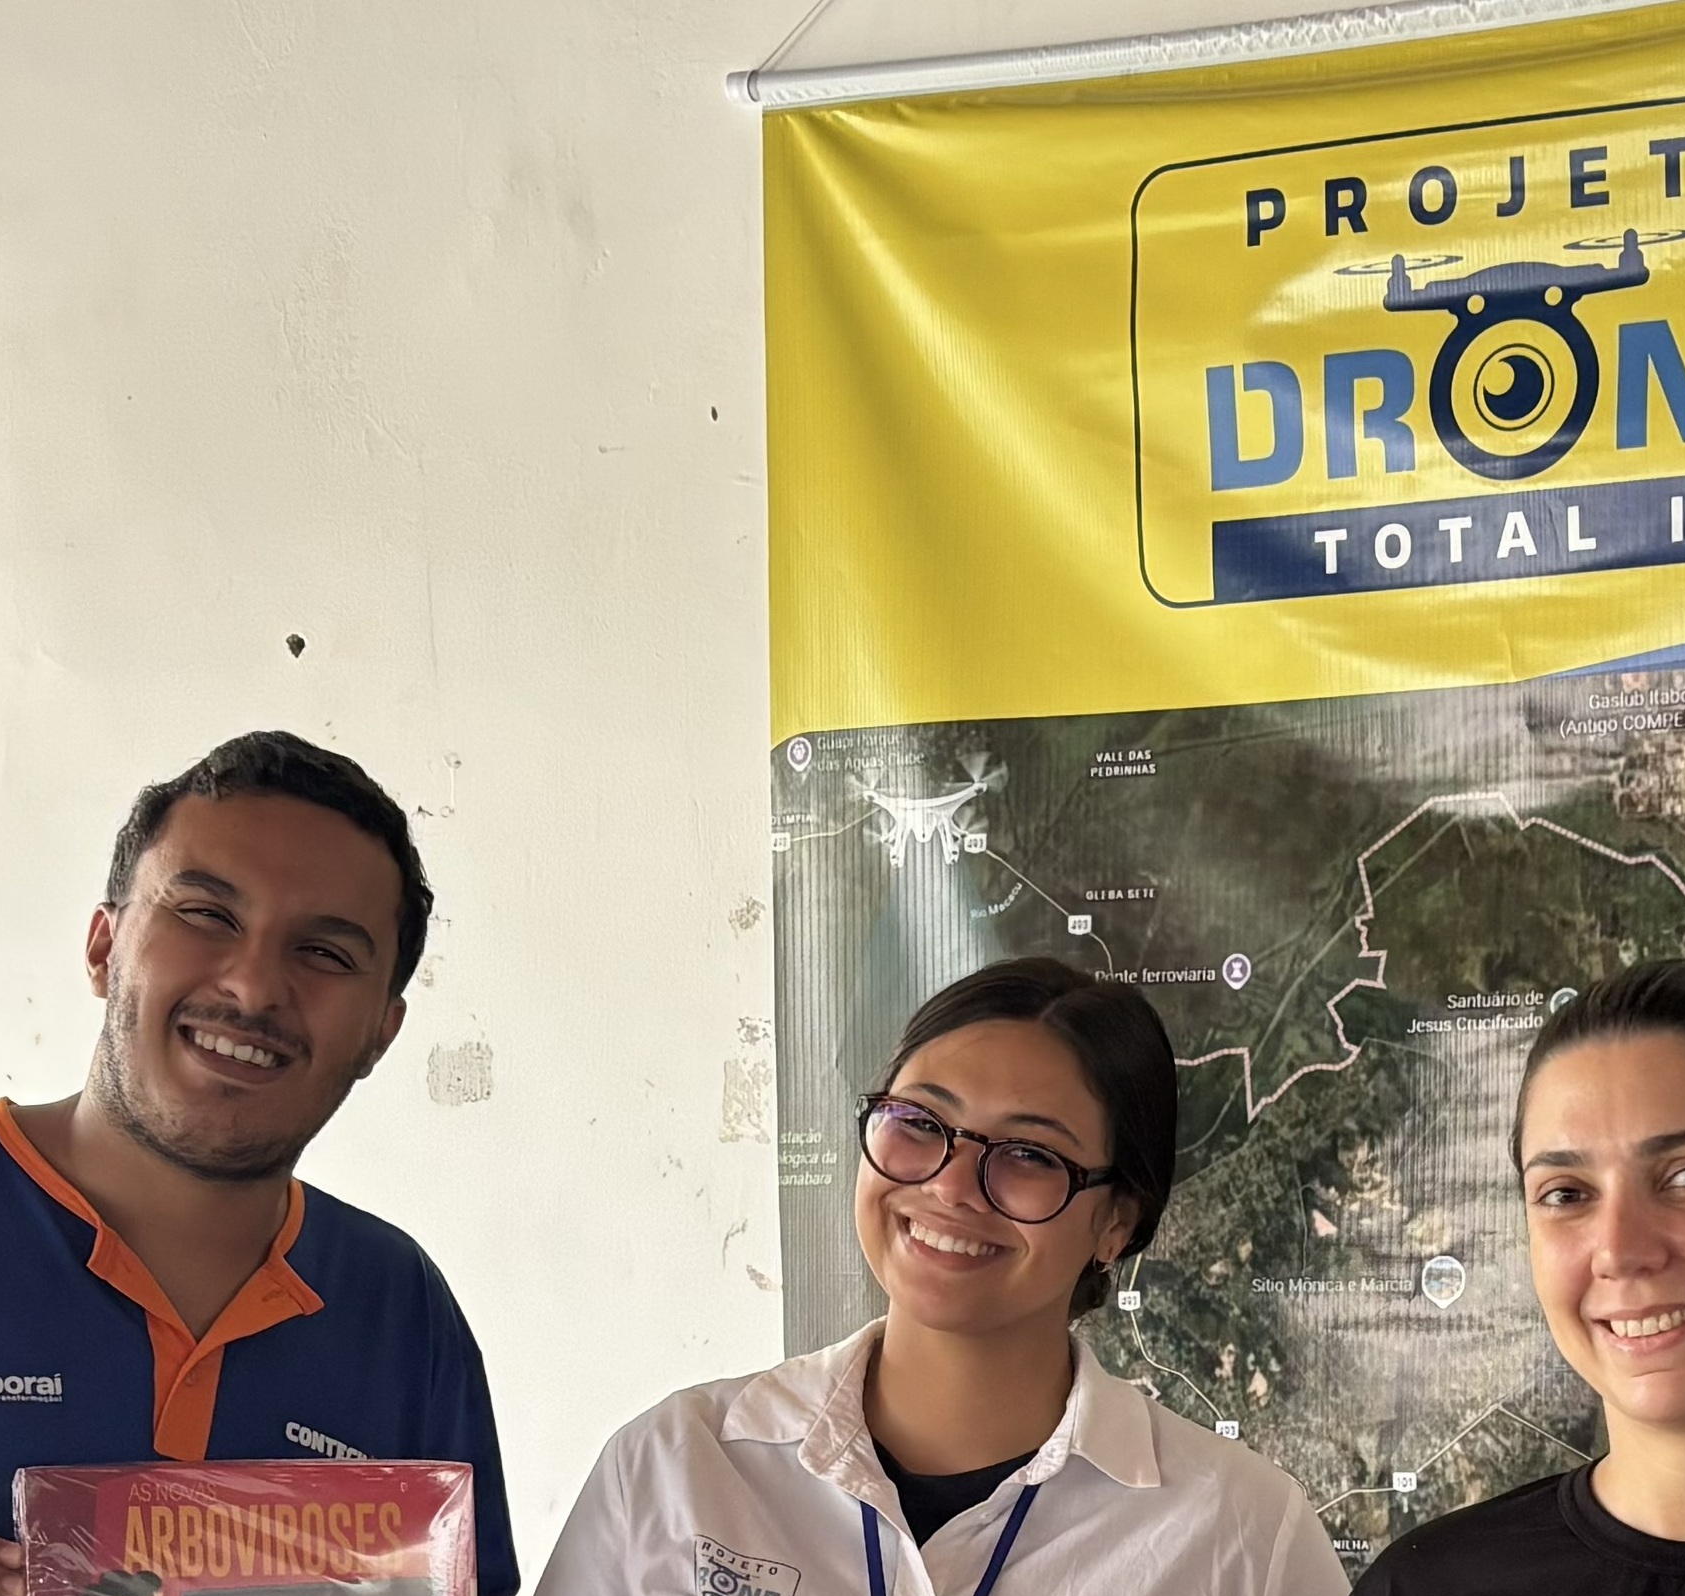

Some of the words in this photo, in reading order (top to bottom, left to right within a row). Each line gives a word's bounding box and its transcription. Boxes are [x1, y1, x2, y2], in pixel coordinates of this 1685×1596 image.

[1314, 506, 1597, 574] TOTAL
[1560, 718, 1617, 738] (Antigo
[1128, 749, 1152, 762] DAS
[1090, 762, 1157, 777] PEDRINHAS
[1525, 989, 1544, 1006] de
[1407, 1019, 1452, 1033] Jesus
[1456, 1013, 1544, 1031] Crucificado
[1348, 1280, 1356, 1292] e
[129, 1482, 152, 1502] AS
[155, 1481, 216, 1502] NOVAS
[123, 1501, 405, 1579] ARBOVIROSES
[1333, 1540, 1370, 1551] NILHA
[702, 1542, 778, 1575] ROJETO
